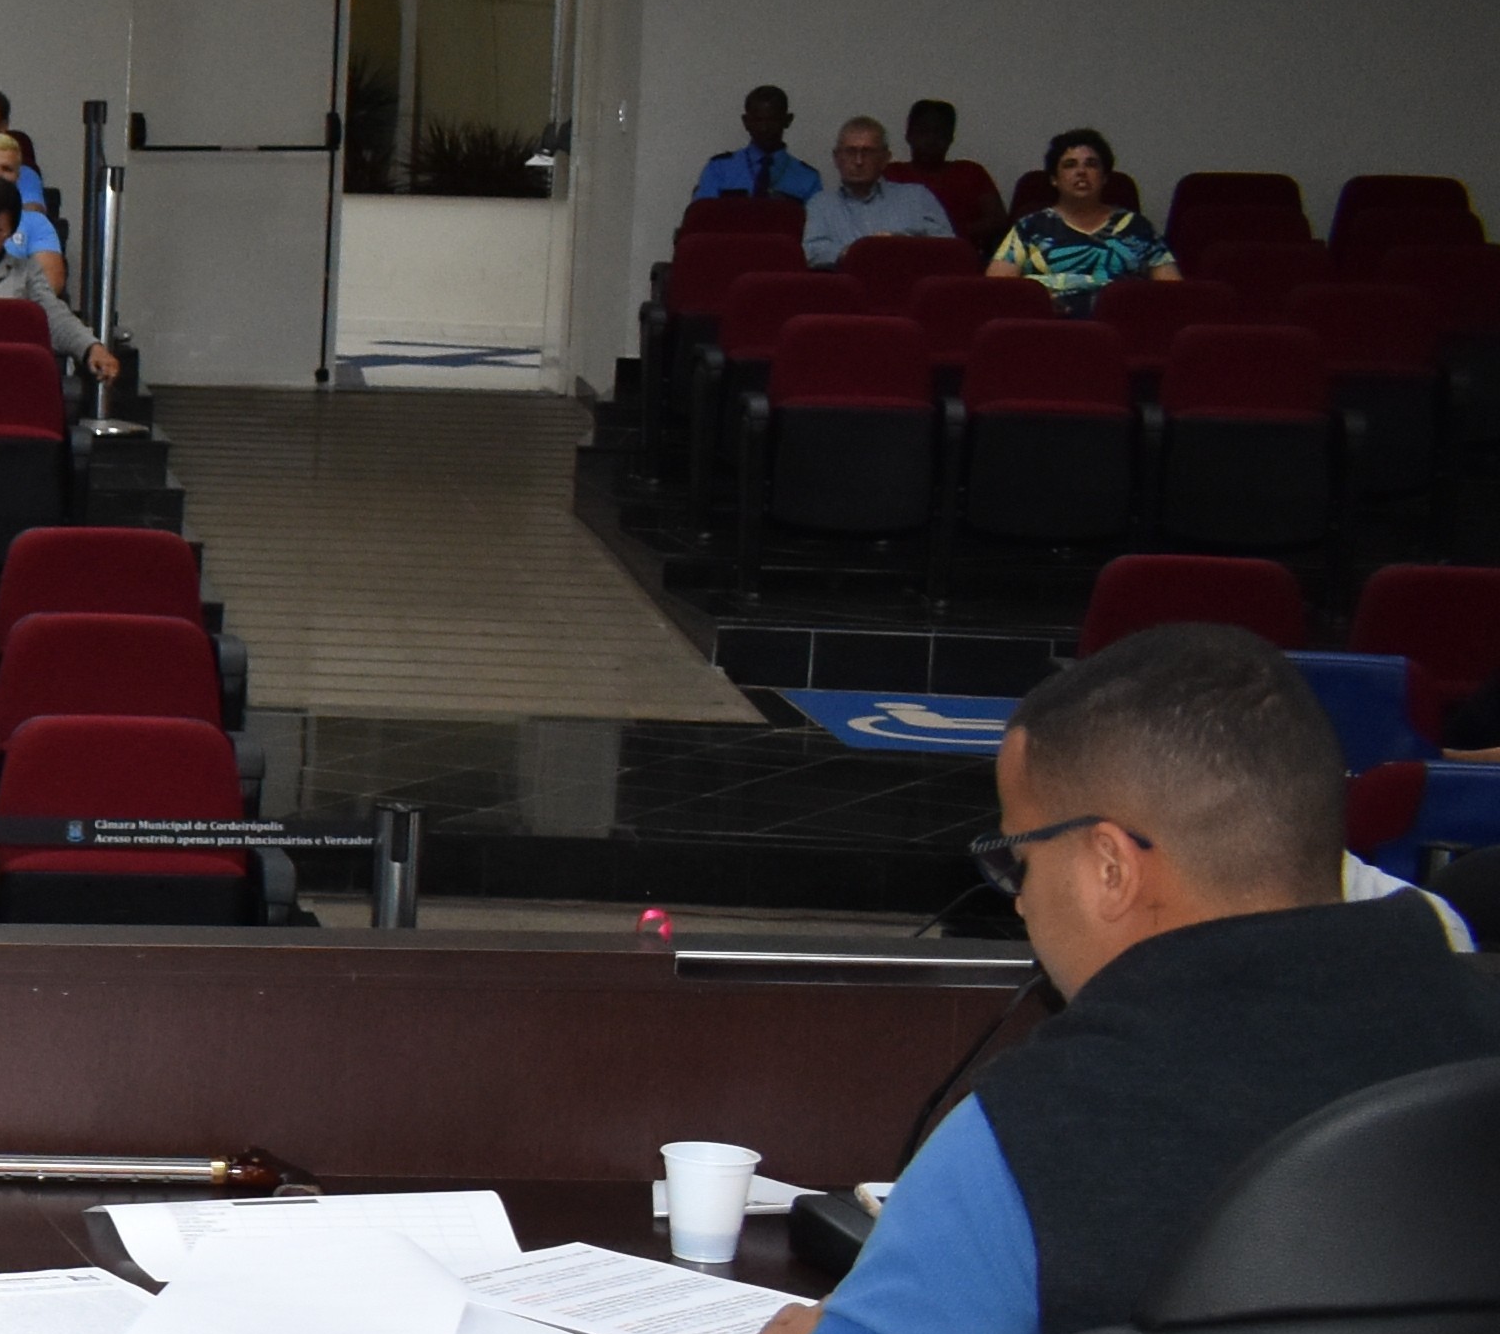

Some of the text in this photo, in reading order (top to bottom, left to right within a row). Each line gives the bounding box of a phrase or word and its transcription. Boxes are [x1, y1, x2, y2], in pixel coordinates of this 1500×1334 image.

[138, 819, 192, 832] Municipal
[193, 821, 207, 830] de
[94, 833, 131, 843] Acesso
[133, 834, 175, 844] restrito
[176, 836, 216, 846] apenas
[217, 836, 243, 846] para
[323, 835, 374, 845] Vereador
